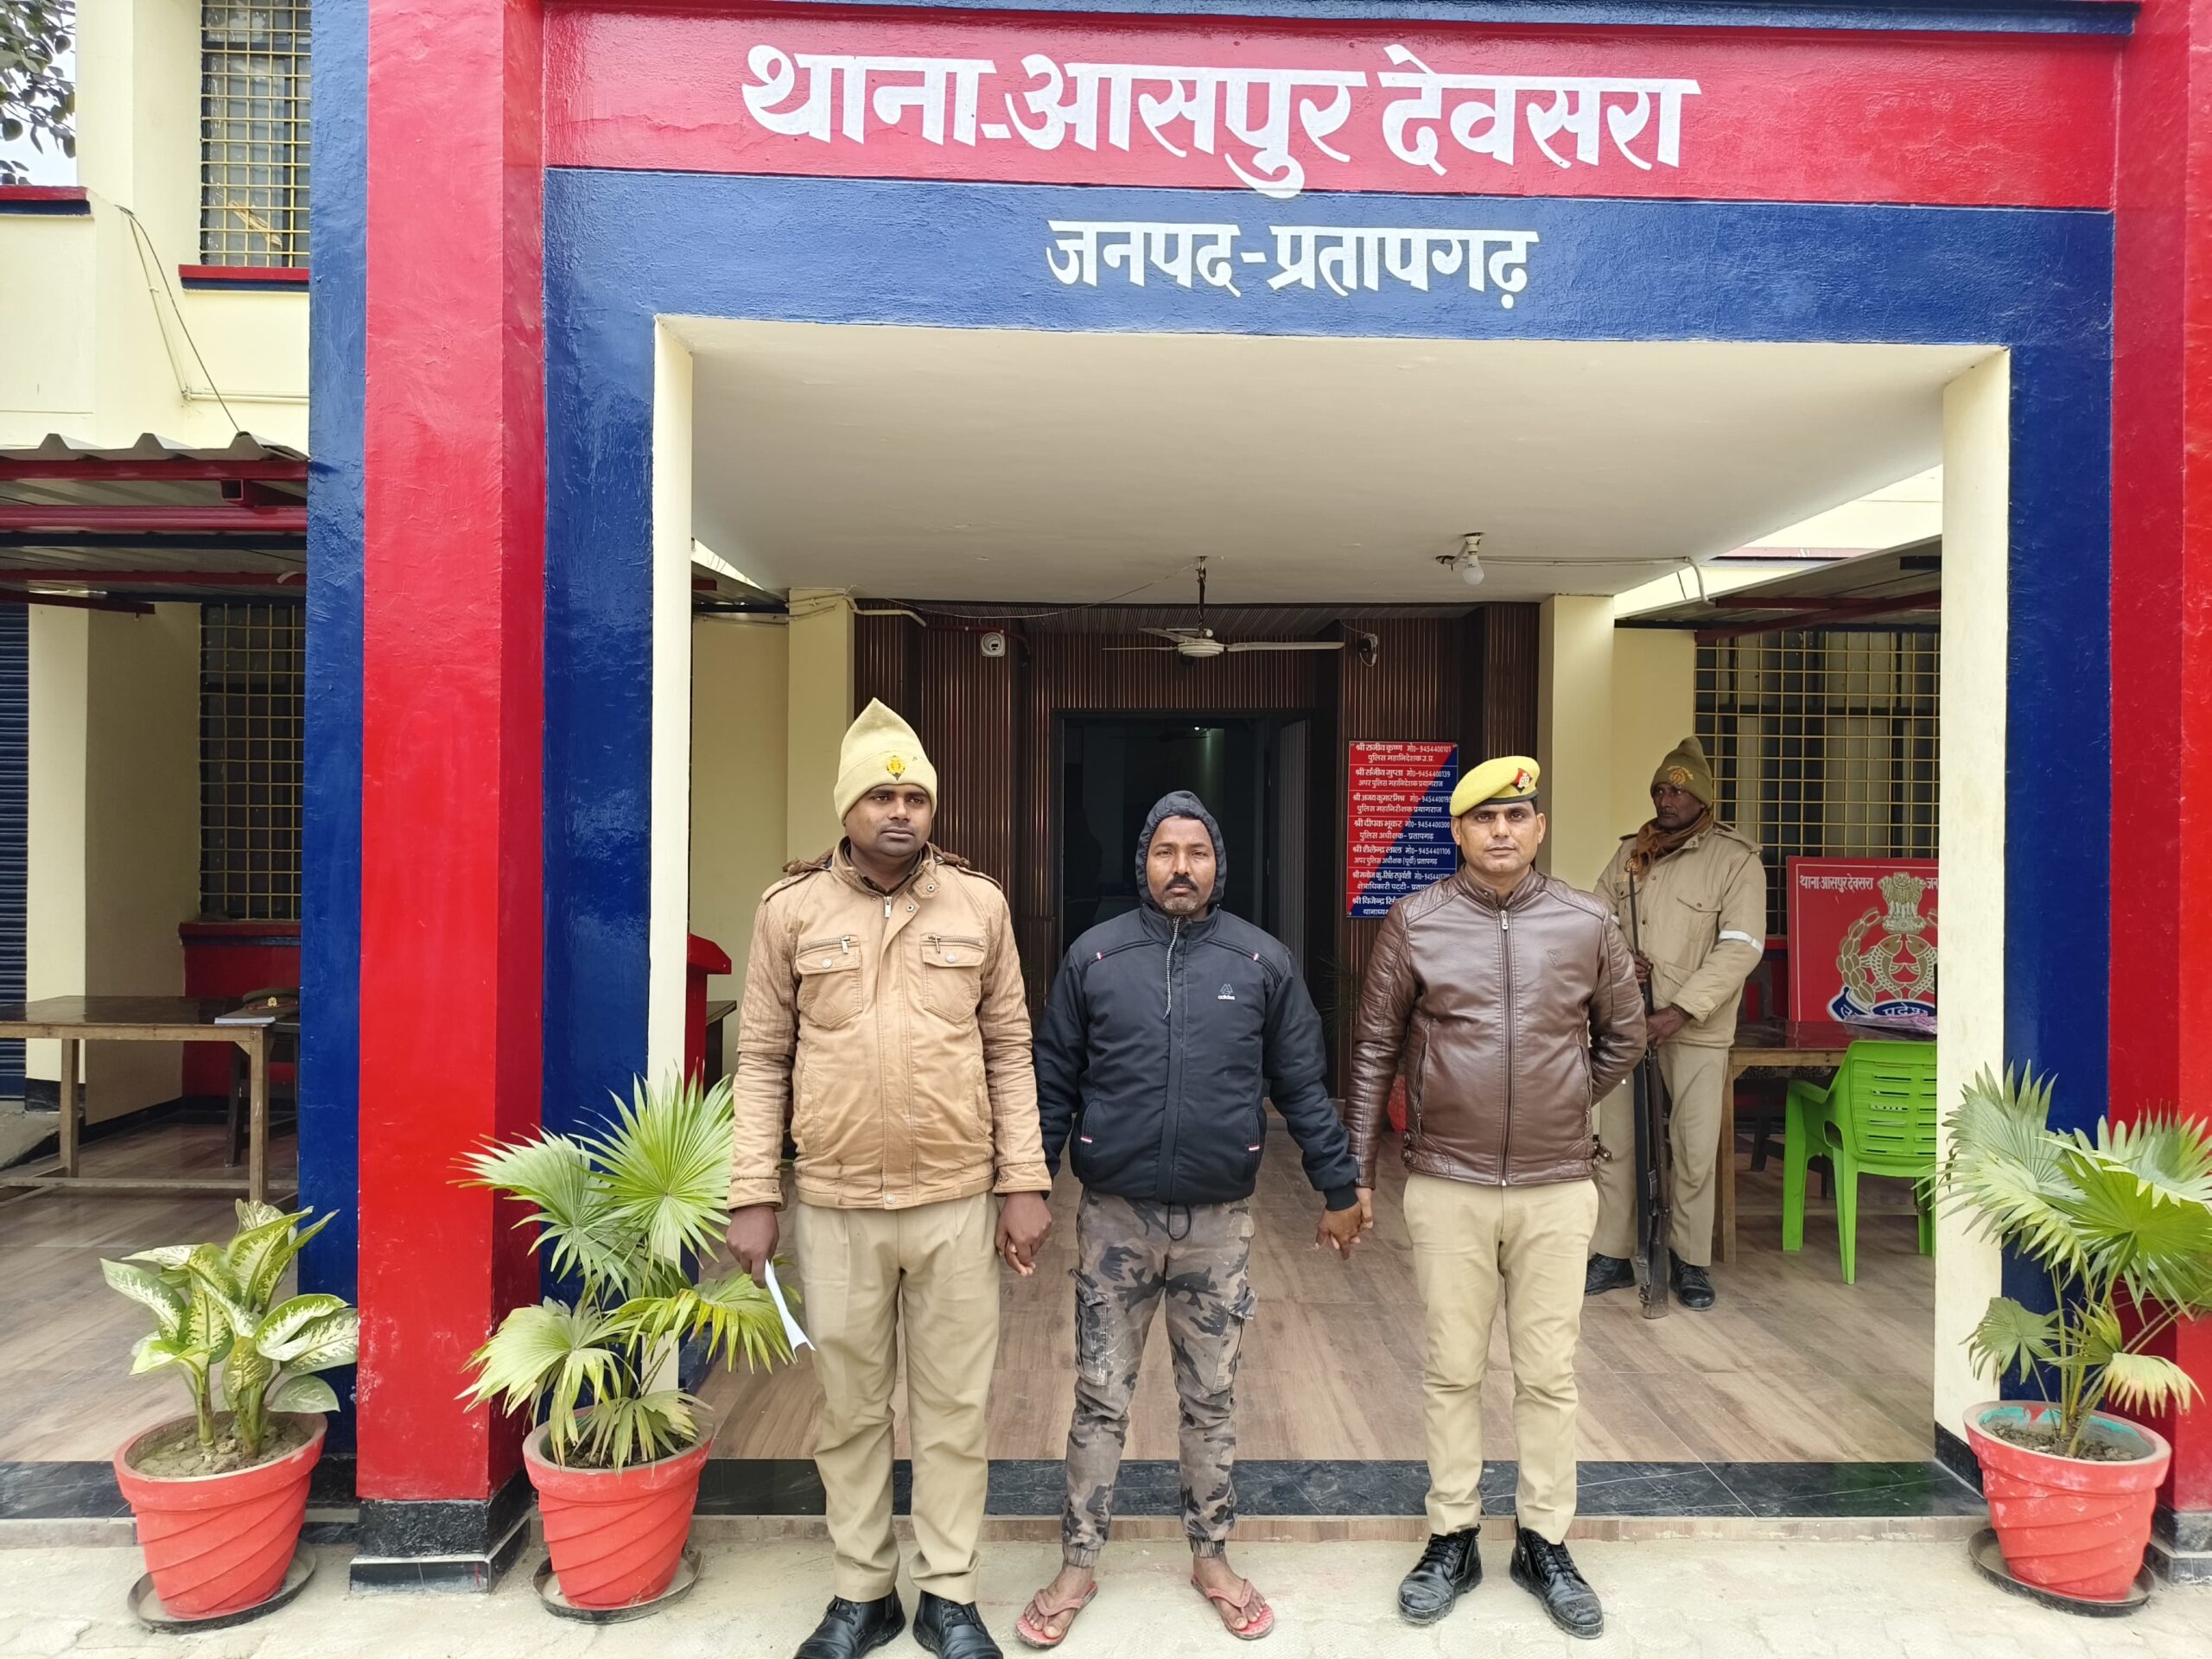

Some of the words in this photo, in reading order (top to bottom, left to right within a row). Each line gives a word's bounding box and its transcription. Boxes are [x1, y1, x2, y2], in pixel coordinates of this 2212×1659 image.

[1376, 43, 1702, 176] देवसरा
[1356, 742, 1365, 752] श्री
[1365, 742, 1385, 752] राजीव
[1386, 744, 1403, 753] कृष्ण
[1368, 753, 1386, 763] पुलिस
[1356, 767, 1364, 776] श्री
[1365, 767, 1385, 776] संजीव
[1386, 769, 1403, 778] गुप्ता
[1372, 778, 1388, 788] पुलिस
[1357, 804, 1376, 814] पुलिस
[1354, 818, 1363, 827] श्री
[1363, 818, 1383, 828] दीपक
[1360, 830, 1377, 841] पुलिस
[1408, 833, 1434, 842] प्रतापगढ़
[1353, 844, 1362, 853] श्री
[1363, 844, 1385, 854] शैलेन्द्र
[1367, 855, 1381, 866] पुलिस
[1800, 874, 1820, 890] थाना
[1820, 876, 1847, 893] आसपुर
[1847, 873, 1874, 893] देवसरा
[1352, 895, 1362, 905] श्री
